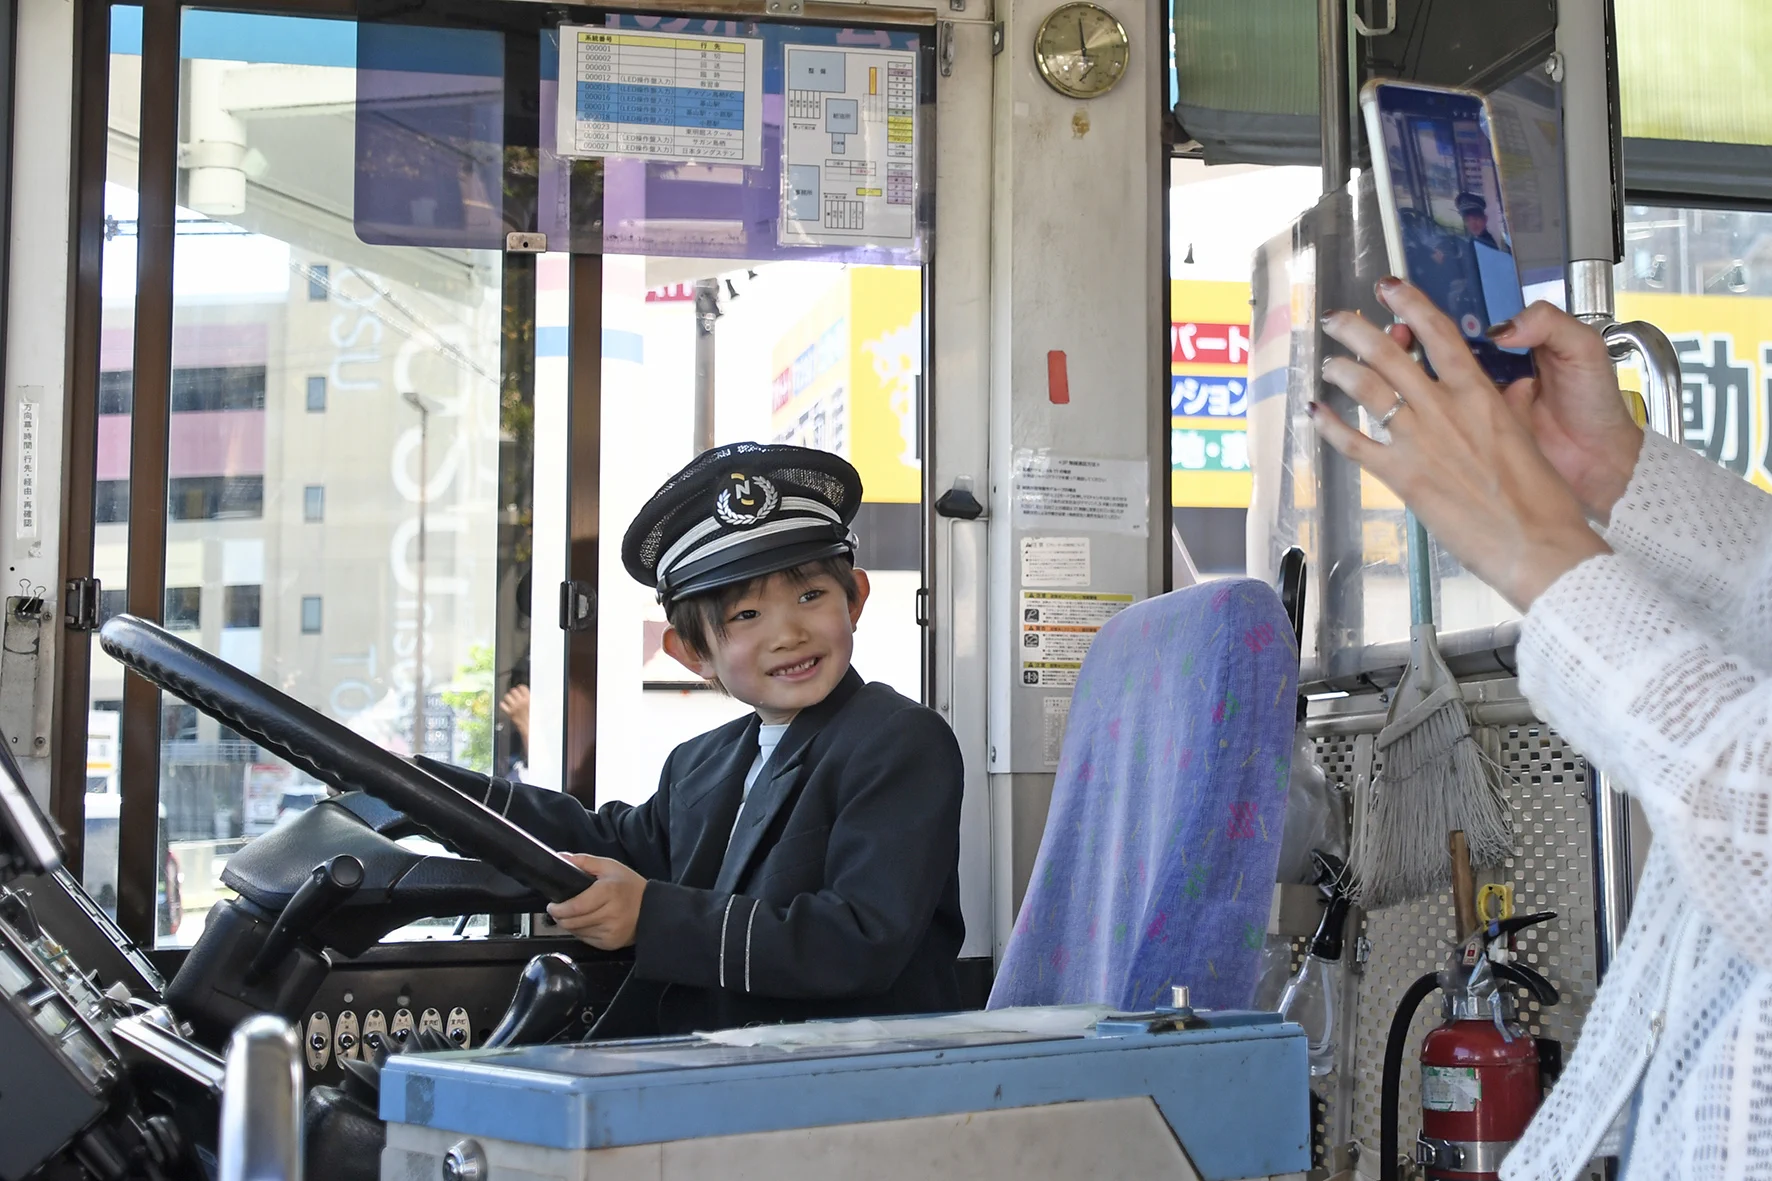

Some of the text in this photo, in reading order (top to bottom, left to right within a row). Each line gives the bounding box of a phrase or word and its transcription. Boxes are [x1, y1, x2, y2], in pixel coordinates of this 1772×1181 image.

[584, 73, 611, 81] 000012
[682, 147, 736, 156] 日本タングステン
[1171, 323, 1250, 363] パート
